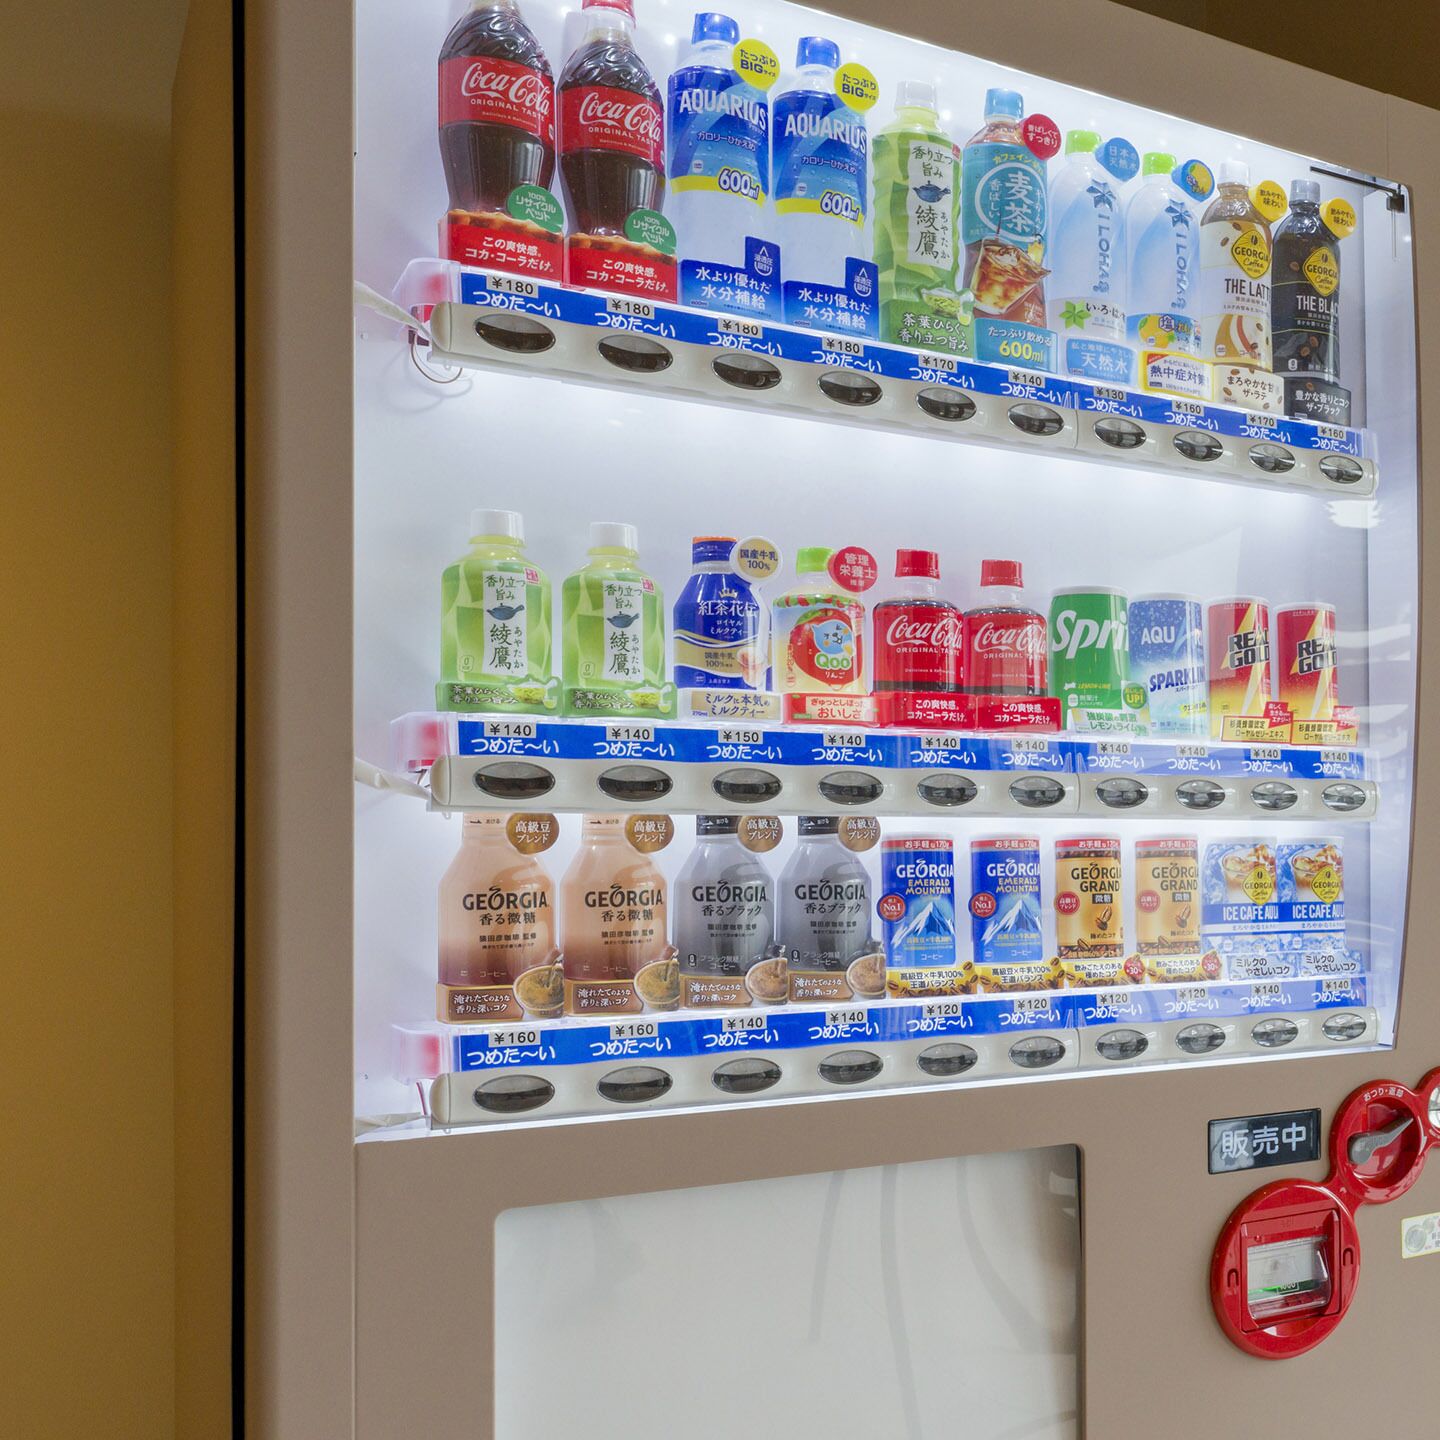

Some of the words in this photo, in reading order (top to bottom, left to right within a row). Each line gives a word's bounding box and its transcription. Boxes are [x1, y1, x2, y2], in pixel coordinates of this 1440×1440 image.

[740, 48, 776, 68] たっぷり
[461, 62, 550, 115] Coca-Cola
[842, 73, 877, 90] たっぷり
[470, 98, 518, 112] ORIGINAL
[521, 107, 545, 122] TASTE
[579, 91, 662, 142] Coca-Cola
[679, 88, 768, 131] AQUARIUS
[588, 126, 633, 139] ORIGINAL
[636, 134, 658, 148] TASTE
[785, 112, 867, 153] AQUARIUS
[1027, 132, 1058, 148] すっきり
[697, 131, 756, 152] カロリーひかえめ
[911, 145, 953, 165] 香り立つ
[802, 156, 857, 174] カロリーひかえめ
[922, 162, 943, 178] 旨み
[718, 168, 759, 200] 600ml
[515, 194, 557, 214] リサイクル
[821, 191, 859, 220] 600ml
[1001, 171, 1035, 232] 麦茶
[525, 206, 551, 222] ペット
[633, 219, 670, 237] リサイクル
[915, 204, 939, 260] 綾鷹
[641, 230, 665, 245] ペット
[482, 236, 542, 257] この爽快感。
[1234, 246, 1269, 262] GEORGIA
[465, 247, 554, 272] コカ・コーラだけ。
[602, 259, 658, 278] この爽快感。
[1306, 264, 1338, 278] GEORGIA
[492, 277, 534, 295] ¥180
[586, 269, 669, 293] コカ・コーラだけ。
[696, 266, 772, 294] 水より優れた
[1224, 278, 1246, 295] THE
[1249, 281, 1271, 301] LATT
[701, 284, 766, 311] 水分補給
[798, 287, 872, 315] 水より優れた
[1296, 295, 1317, 311] THE
[611, 300, 650, 316] ¥180
[804, 305, 867, 331] 水分補給
[903, 312, 966, 338] 茶葉ひらく、
[722, 319, 759, 336] ¥180
[898, 329, 969, 353] 香り立つ旨み
[988, 325, 1052, 347] たっぷり飲める
[826, 338, 860, 354] ¥180
[999, 342, 1045, 363] 600ml
[922, 355, 954, 371] ¥170
[1081, 352, 1128, 374] 天然水
[1012, 372, 1042, 386] ¥140
[1096, 388, 1124, 401] ¥130
[1295, 390, 1350, 409] 豊かな香りとコク
[1175, 402, 1201, 414] ¥160
[1306, 402, 1341, 416] ザ・ブラック
[1250, 415, 1275, 427] ¥170
[1320, 427, 1344, 440] ¥160
[740, 548, 778, 562] 国産牛乳
[844, 553, 869, 566] 管理
[839, 564, 875, 579] 栄養士
[484, 574, 526, 589] 香り立つ
[495, 588, 515, 601] 旨み
[604, 584, 642, 597] 香り立つ
[698, 600, 759, 618] 紅茶花伝
[716, 619, 743, 627] ロイヤル
[886, 615, 963, 649] Coca-Cola
[1052, 609, 1128, 660] Spri
[489, 623, 512, 670] 綾鷹
[513, 626, 524, 669] あやたか
[1229, 628, 1269, 653] REAL
[609, 631, 630, 676] 綾鷹
[815, 653, 851, 669] Qoo
[825, 671, 846, 679] りんご
[1150, 666, 1206, 693] SPARKLIN
[705, 693, 770, 707] ミルクに本気の
[711, 704, 765, 717] ミルクティー
[817, 707, 862, 719] おいしさ
[490, 724, 532, 736] ¥140
[611, 728, 651, 740] ¥140
[723, 731, 759, 743] ¥150
[828, 735, 862, 746] ¥140
[925, 737, 957, 748] ¥140
[1015, 740, 1045, 751] ¥140
[1100, 743, 1128, 754] ¥140
[1179, 747, 1206, 757] ¥140
[1253, 749, 1279, 759] ¥140
[1324, 752, 1347, 761] ¥140
[515, 821, 551, 833] 高級豆
[633, 821, 667, 833] 高級豆
[517, 833, 549, 844] ブレンド
[635, 833, 665, 843] ブレンド
[905, 886, 952, 895] MOUNTAIN
[908, 879, 950, 887] EMERALD
[995, 885, 1039, 893] MOUNTAIN
[1080, 881, 1120, 892] GRAND
[1160, 879, 1198, 891] GRAND
[462, 885, 549, 911] GEORGIA
[584, 883, 664, 908] GEORGIA
[691, 879, 767, 903] GEORGIA
[702, 903, 763, 917] 香るブラック
[804, 902, 862, 915] 香るブラック
[883, 902, 901, 912] No.1
[1223, 906, 1238, 921] ICE
[1240, 905, 1263, 920] CAFE
[1292, 905, 1307, 919] ICE
[1309, 904, 1331, 918] CAFE
[479, 912, 536, 926] 香る微糖
[600, 909, 654, 923] 香る微糖
[1236, 958, 1267, 967] ミルクの
[1315, 963, 1357, 972] やさしいコク
[901, 970, 964, 981] 高級豆×牛乳100%
[1246, 966, 1290, 976] やさしいコク
[910, 980, 956, 989] 王道バランス
[1001, 975, 1044, 984] 王道バランス
[1325, 980, 1349, 990] ¥140
[1179, 988, 1206, 998] ¥120
[1254, 985, 1279, 994] ¥140
[453, 993, 511, 1004] 淹れたてのような
[1017, 999, 1047, 1009] ¥120
[1100, 994, 1128, 1004] ¥120
[927, 1004, 958, 1015] ¥120
[727, 1017, 763, 1029] ¥140
[830, 1012, 864, 1023] ¥140
[615, 1024, 654, 1036] ¥160
[494, 1032, 536, 1044] ¥160
[1221, 1122, 1307, 1159] 販売中
